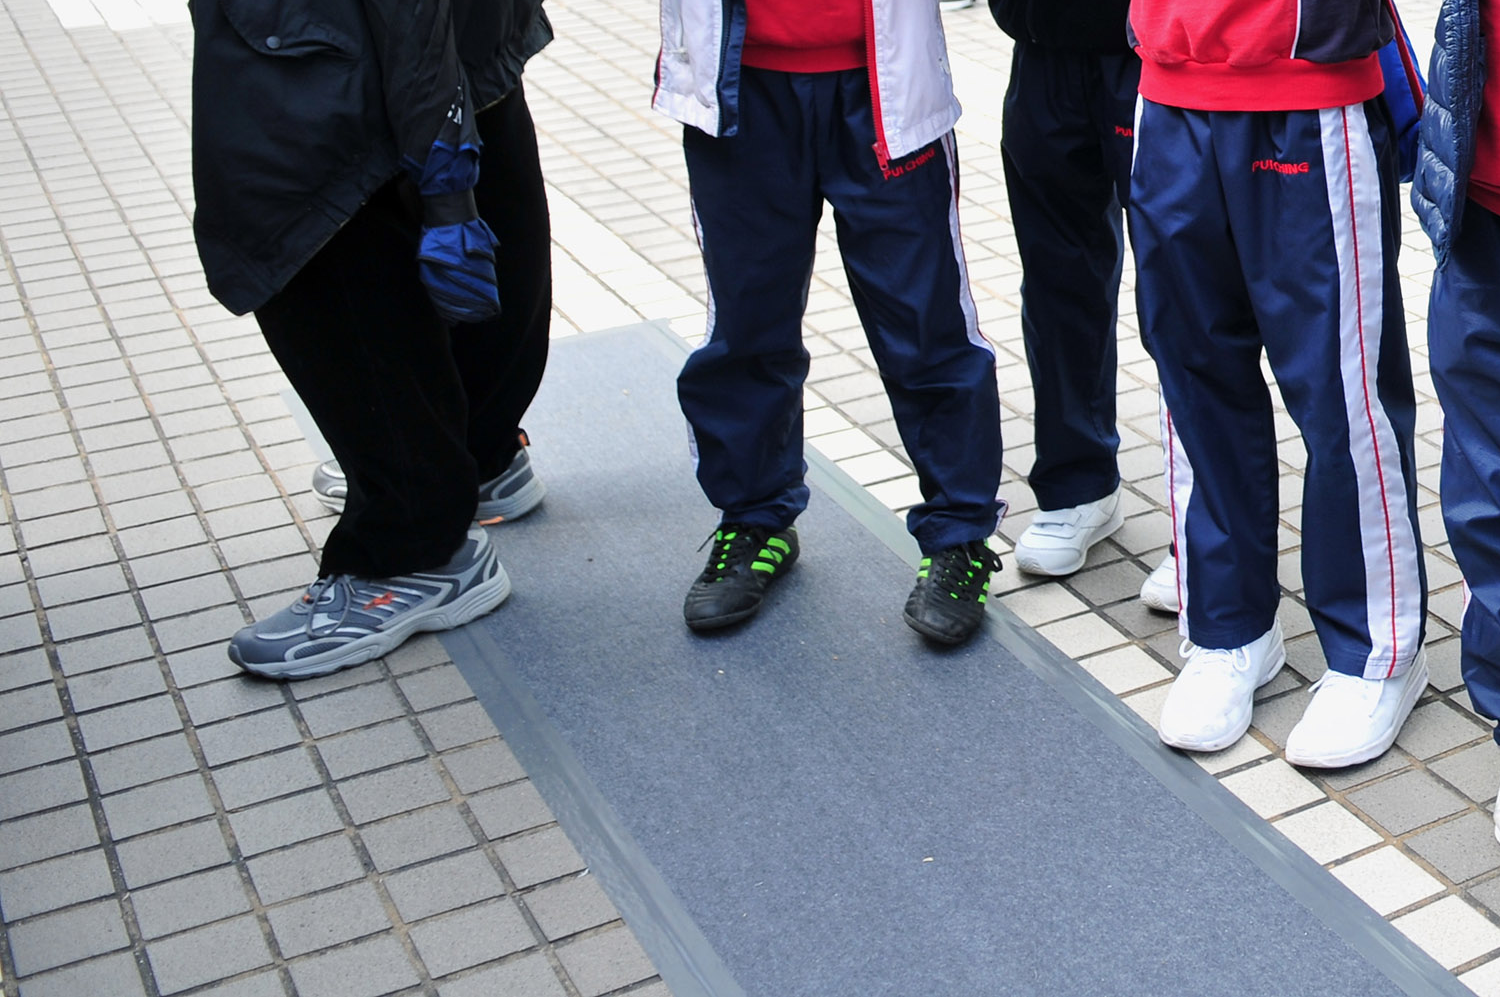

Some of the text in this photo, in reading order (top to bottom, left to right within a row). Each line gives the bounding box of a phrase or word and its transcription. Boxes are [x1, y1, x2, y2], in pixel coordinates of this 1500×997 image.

[883, 165, 904, 180] PUI
[1252, 159, 1310, 175] PUI CHING
